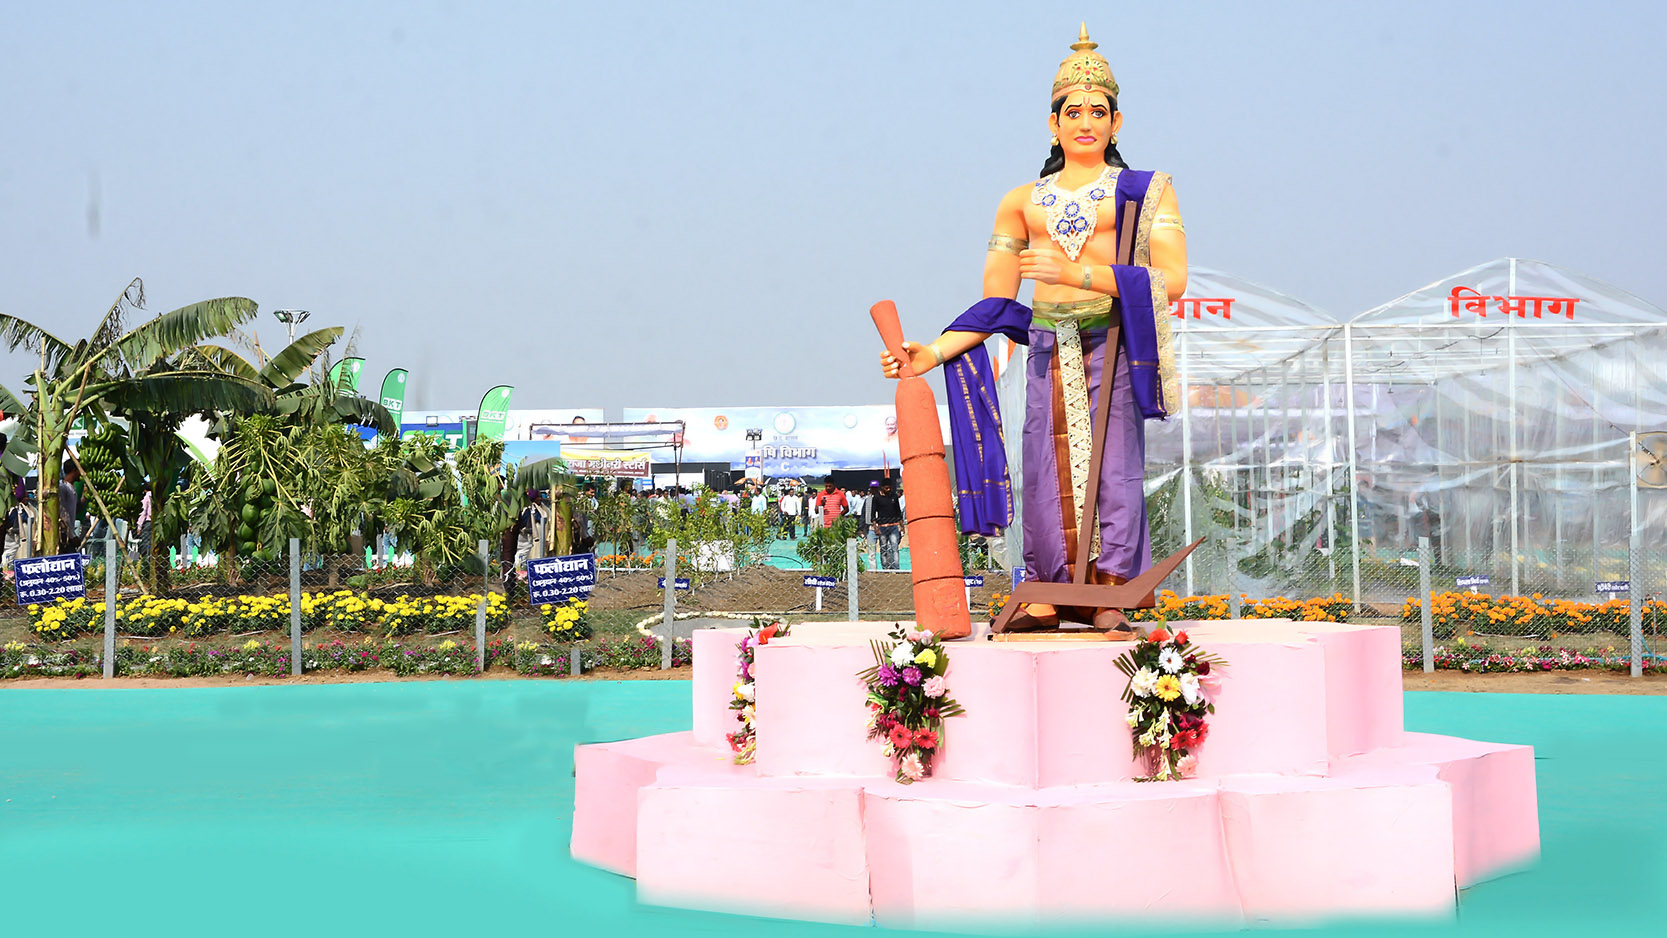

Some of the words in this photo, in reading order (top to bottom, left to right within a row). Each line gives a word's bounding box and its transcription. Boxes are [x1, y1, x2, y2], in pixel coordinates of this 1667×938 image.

[1447, 286, 1580, 320] विभाग
[383, 399, 401, 409] BKT
[763, 444, 777, 460] षि
[780, 444, 818, 460] विभाग
[781, 461, 790, 472] C
[20, 558, 76, 575] फलोद्यान
[533, 558, 589, 575] फलोद्यान
[30, 586, 66, 597] 0.30-2.20
[542, 586, 578, 597] 0.30-2.20
